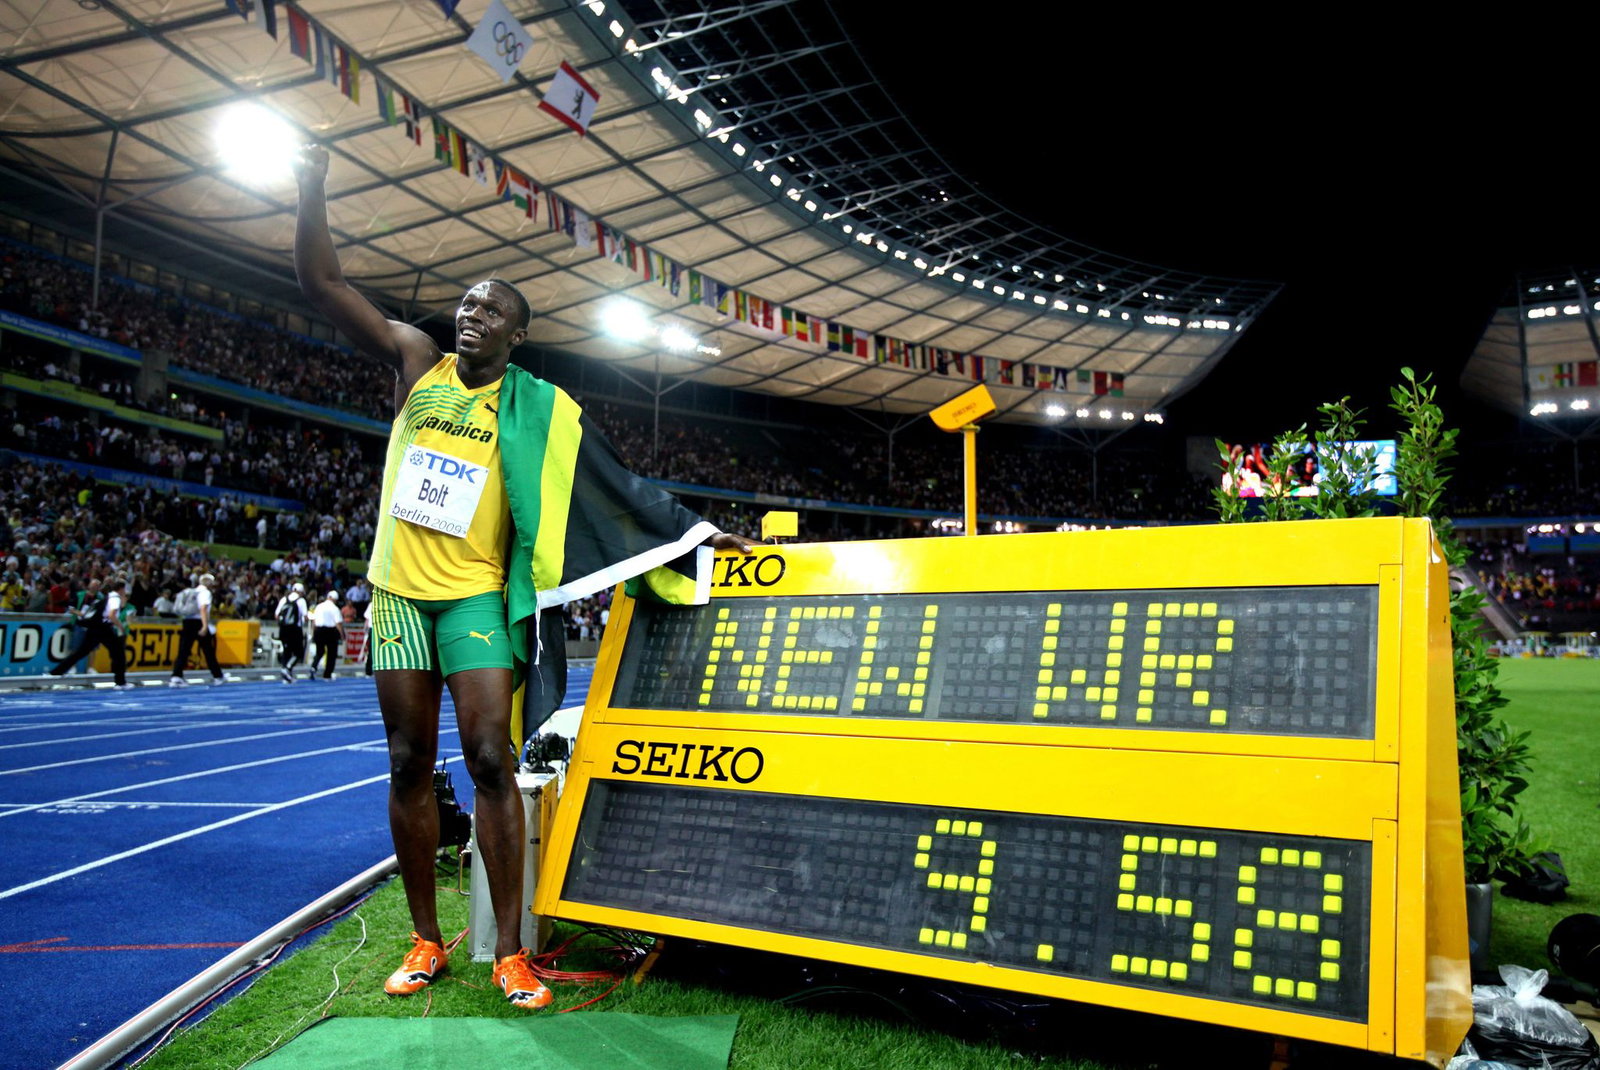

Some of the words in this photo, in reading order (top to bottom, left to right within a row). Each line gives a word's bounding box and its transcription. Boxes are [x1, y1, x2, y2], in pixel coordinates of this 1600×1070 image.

[426, 452, 480, 484] TDK
[418, 478, 449, 508] Bolt
[392, 503, 430, 525] berlin
[431, 517, 463, 535] 2009
[699, 605, 938, 713] NEW
[1033, 602, 1235, 725] WR
[612, 740, 764, 784] SEIKO
[914, 818, 1343, 1001] 9.58
